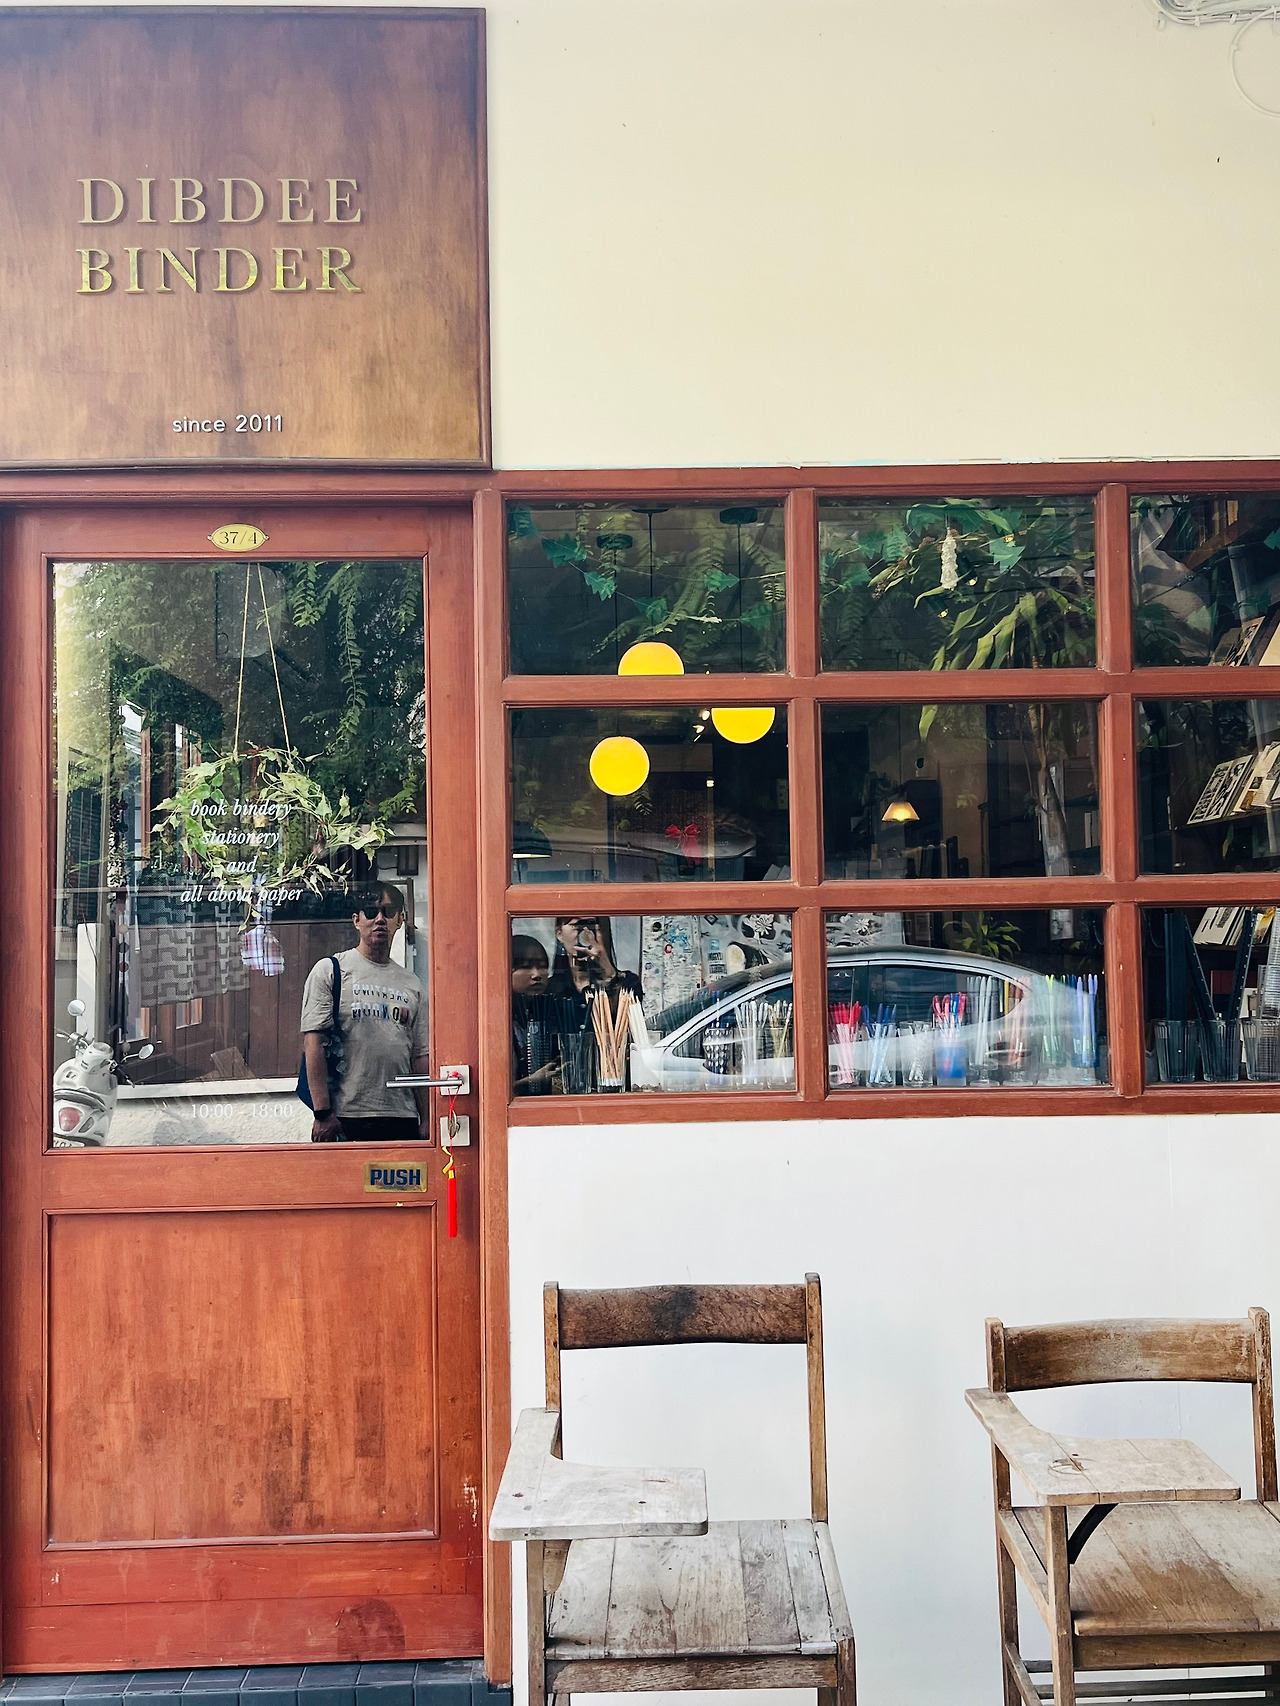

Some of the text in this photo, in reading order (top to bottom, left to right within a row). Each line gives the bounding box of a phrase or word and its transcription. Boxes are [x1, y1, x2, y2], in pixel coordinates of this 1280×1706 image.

[77, 177, 362, 224] DIBDEE
[76, 246, 362, 293] BINDER
[172, 414, 283, 433] since 2011
[219, 530, 257, 545] 37/4
[190, 799, 293, 821] book bindery
[202, 827, 280, 849] stationery
[226, 855, 258, 873] and
[180, 885, 304, 906] all about paper
[191, 1102, 293, 1119] 10:00 18:00
[370, 1168, 421, 1186] PUSH
